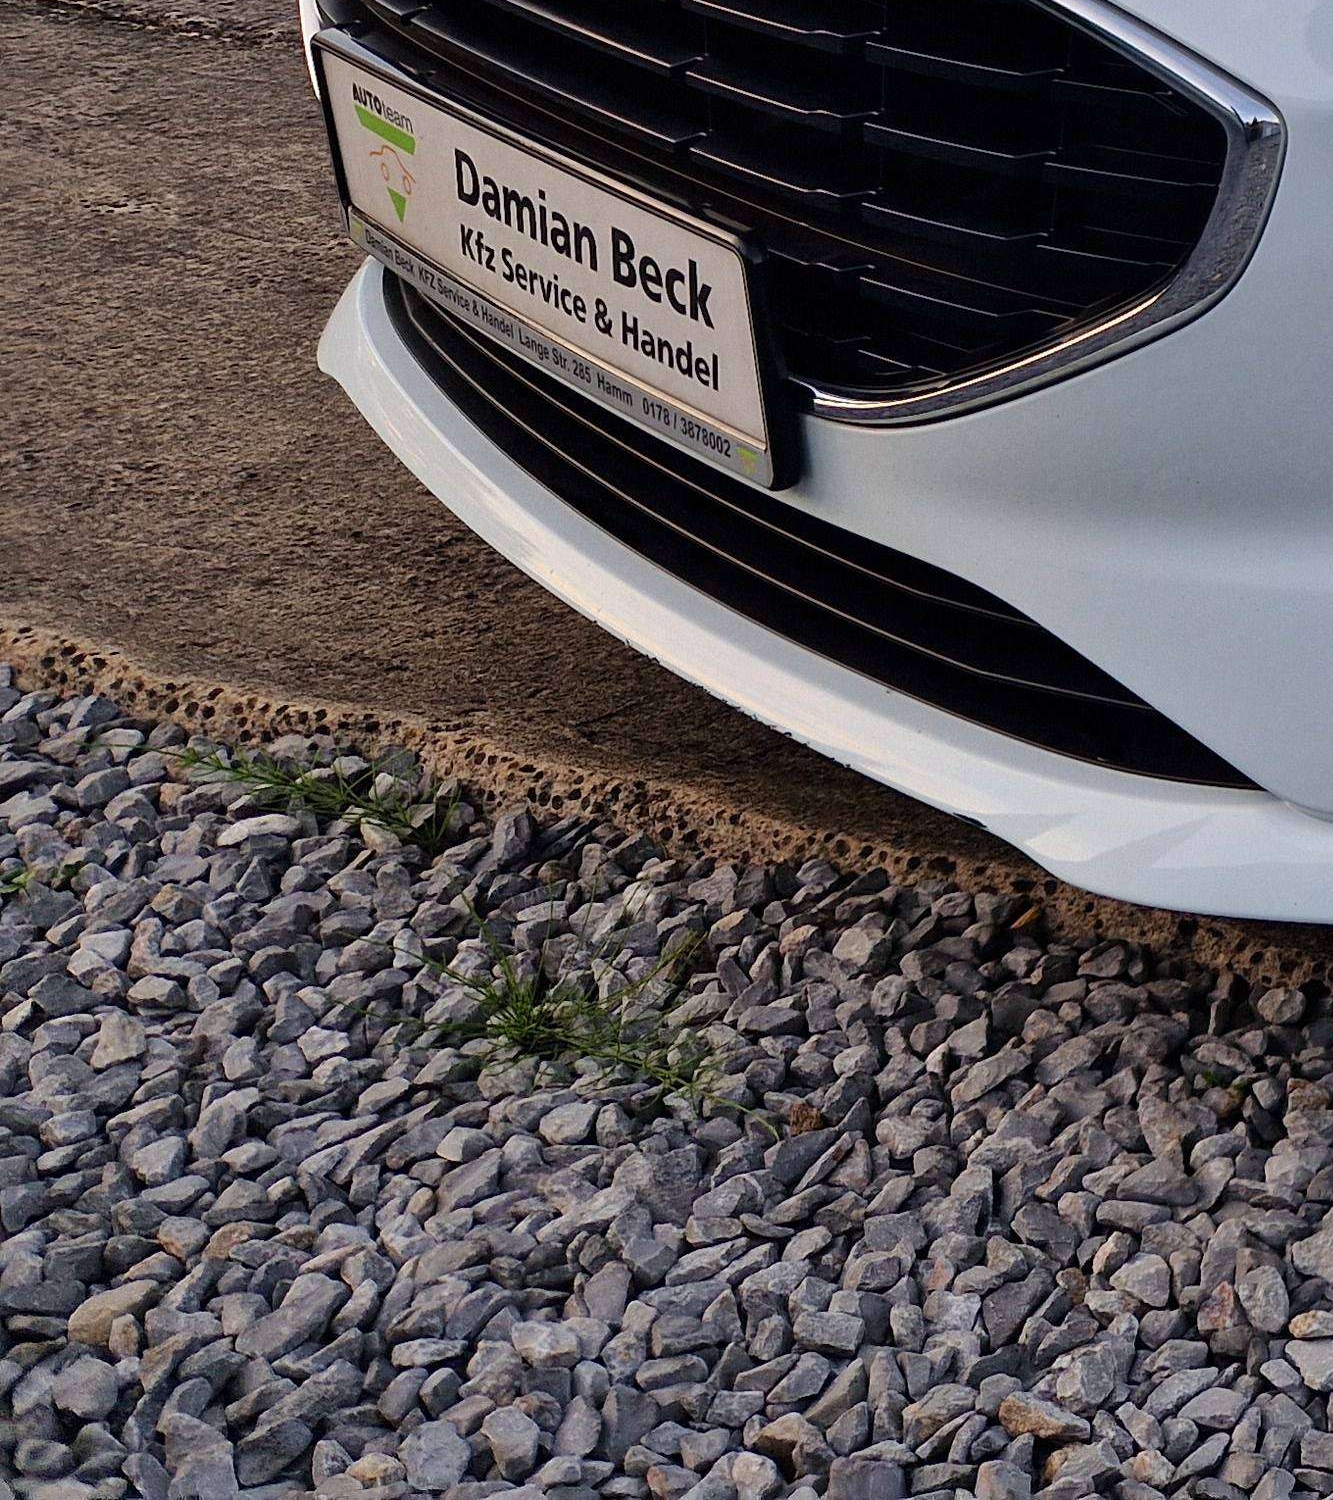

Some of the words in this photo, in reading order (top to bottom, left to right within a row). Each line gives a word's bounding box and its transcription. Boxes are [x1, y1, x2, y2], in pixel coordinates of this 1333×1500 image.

[352, 82, 414, 135] AUTOteam
[455, 147, 598, 273] Damian
[611, 226, 715, 330] Beck
[460, 223, 496, 273] Kfz
[501, 247, 587, 324] Service
[594, 298, 613, 338] &
[621, 310, 720, 392] Handel
[365, 229, 395, 263] Damian
[395, 251, 415, 275] Beck
[418, 266, 436, 290] KFZ
[437, 279, 471, 312] Service
[472, 300, 480, 316] &
[481, 305, 514, 340] Handel
[518, 327, 550, 360] Lange
[552, 349, 570, 373] Str.
[573, 360, 591, 384] 285
[597, 372, 633, 407] Hamm
[642, 397, 670, 426] 0178
[681, 416, 732, 459] 3878002
